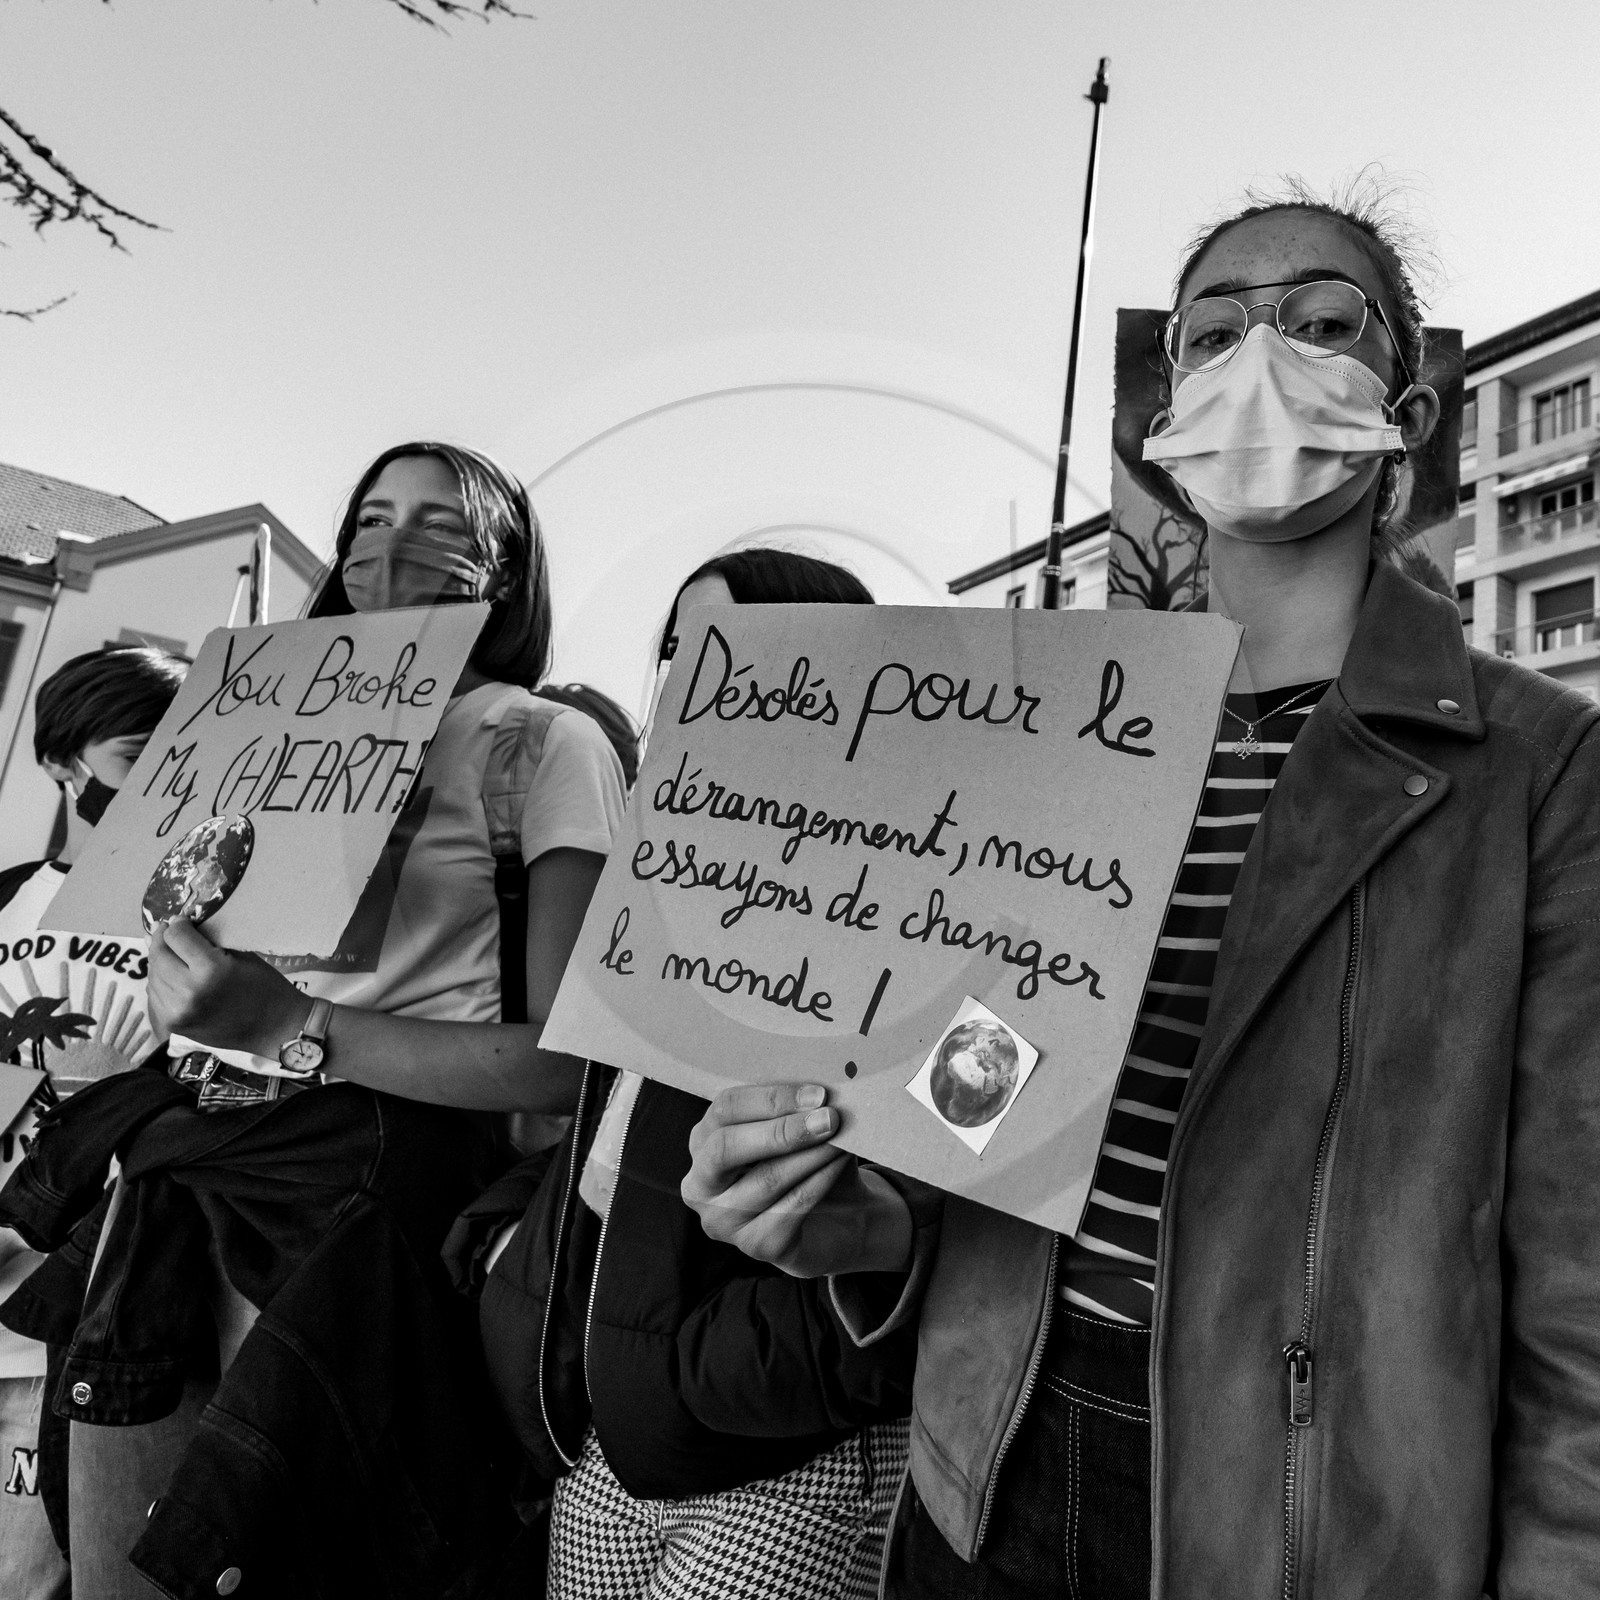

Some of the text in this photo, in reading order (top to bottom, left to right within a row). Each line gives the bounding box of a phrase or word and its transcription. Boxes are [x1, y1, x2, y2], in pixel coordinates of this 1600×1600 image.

[177, 634, 436, 735] You Broke
[678, 625, 1156, 762] Désolés pour le
[143, 741, 198, 838] My
[654, 752, 1132, 909] dérangement, nous
[68, 936, 149, 980] VIBES
[599, 907, 634, 975] le
[662, 954, 833, 1022] monde
[632, 840, 1105, 1000] essayons de changer
